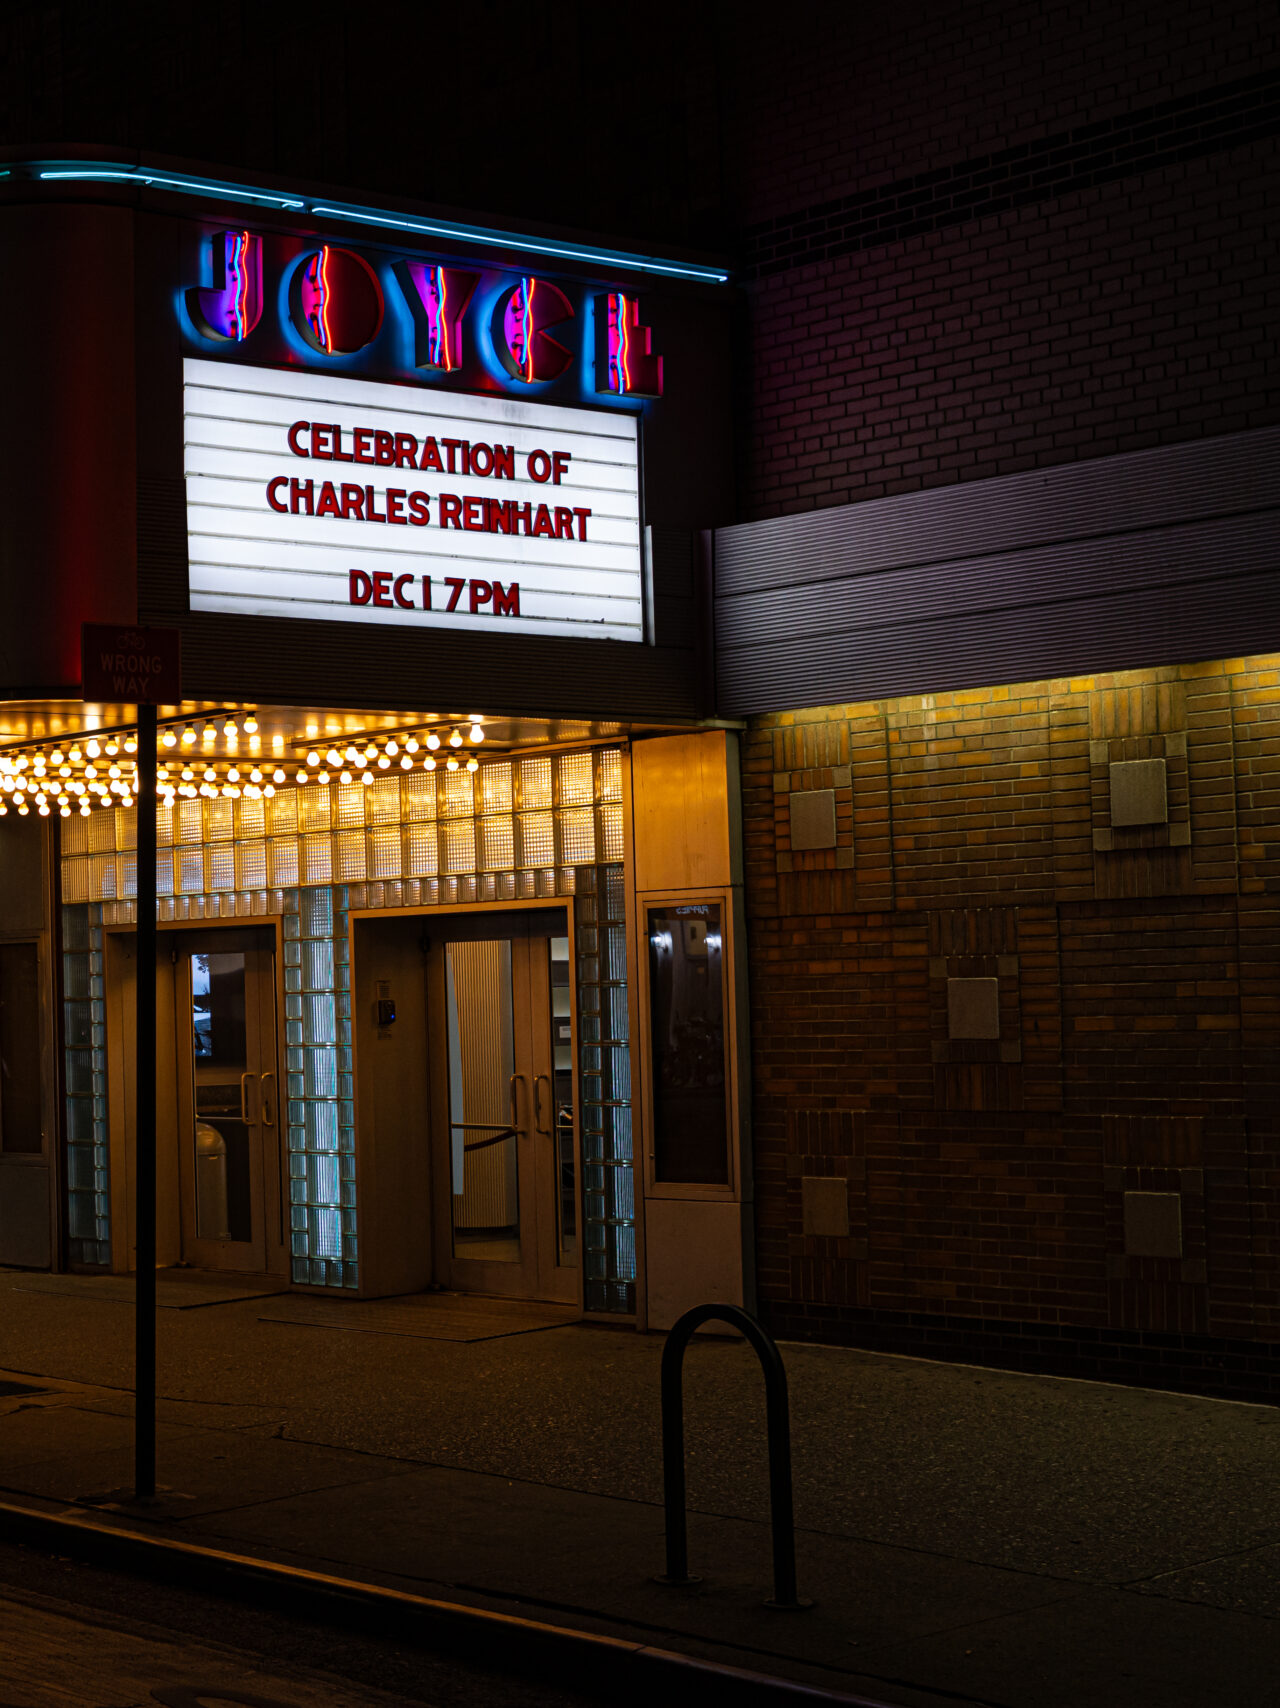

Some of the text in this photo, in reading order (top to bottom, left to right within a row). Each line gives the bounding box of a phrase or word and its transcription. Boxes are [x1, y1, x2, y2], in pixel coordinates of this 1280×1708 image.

[185, 230, 665, 399] JOYCE
[288, 420, 572, 485] CELEBRATION OF
[266, 476, 591, 542] CHARLES REINHART
[349, 568, 414, 610] DEC
[100, 652, 162, 674] WRONG
[112, 675, 150, 698] WAY
